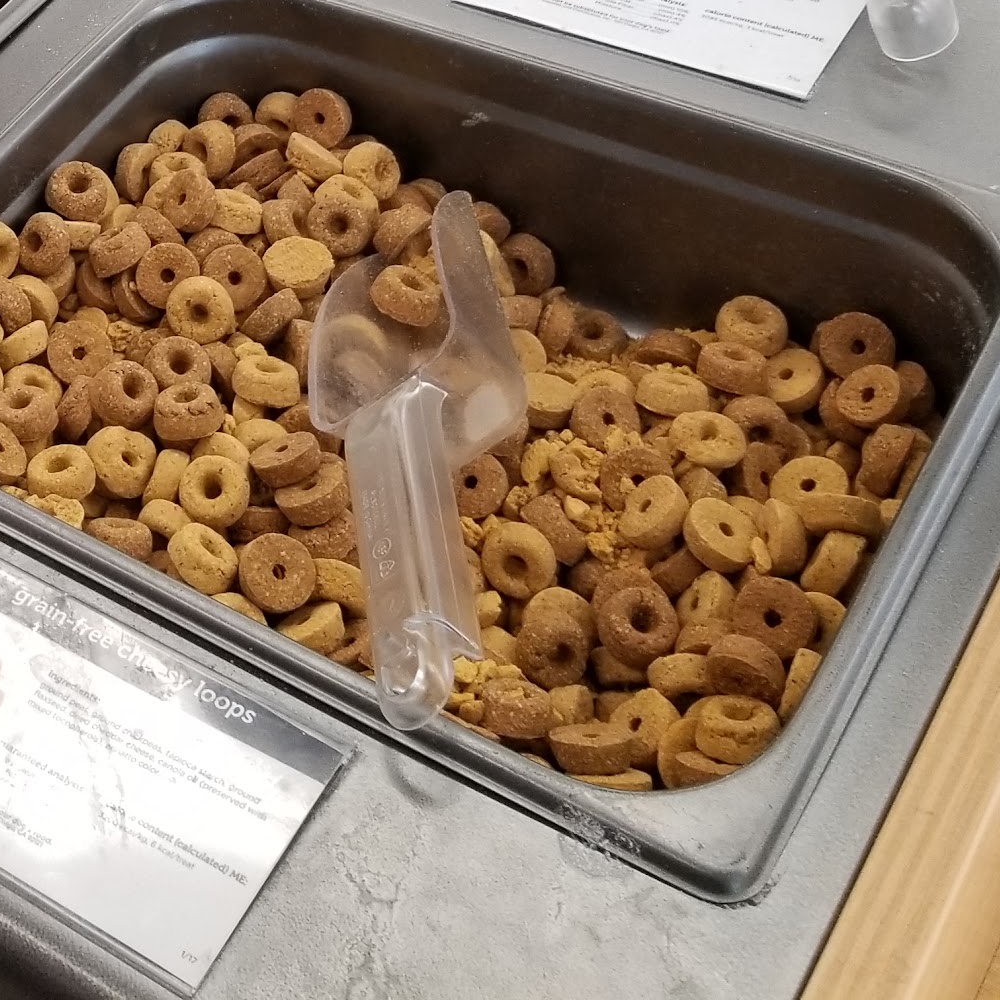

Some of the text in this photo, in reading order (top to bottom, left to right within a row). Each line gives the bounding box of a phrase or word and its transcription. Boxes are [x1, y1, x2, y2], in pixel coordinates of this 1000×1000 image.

[12, 587, 115, 648] grain-free
[194, 680, 257, 724] loops
[0, 740, 48, 771] uaranteed
[137, 820, 174, 844] content
[174, 838, 230, 875] (calculated)
[228, 784, 262, 805] ground
